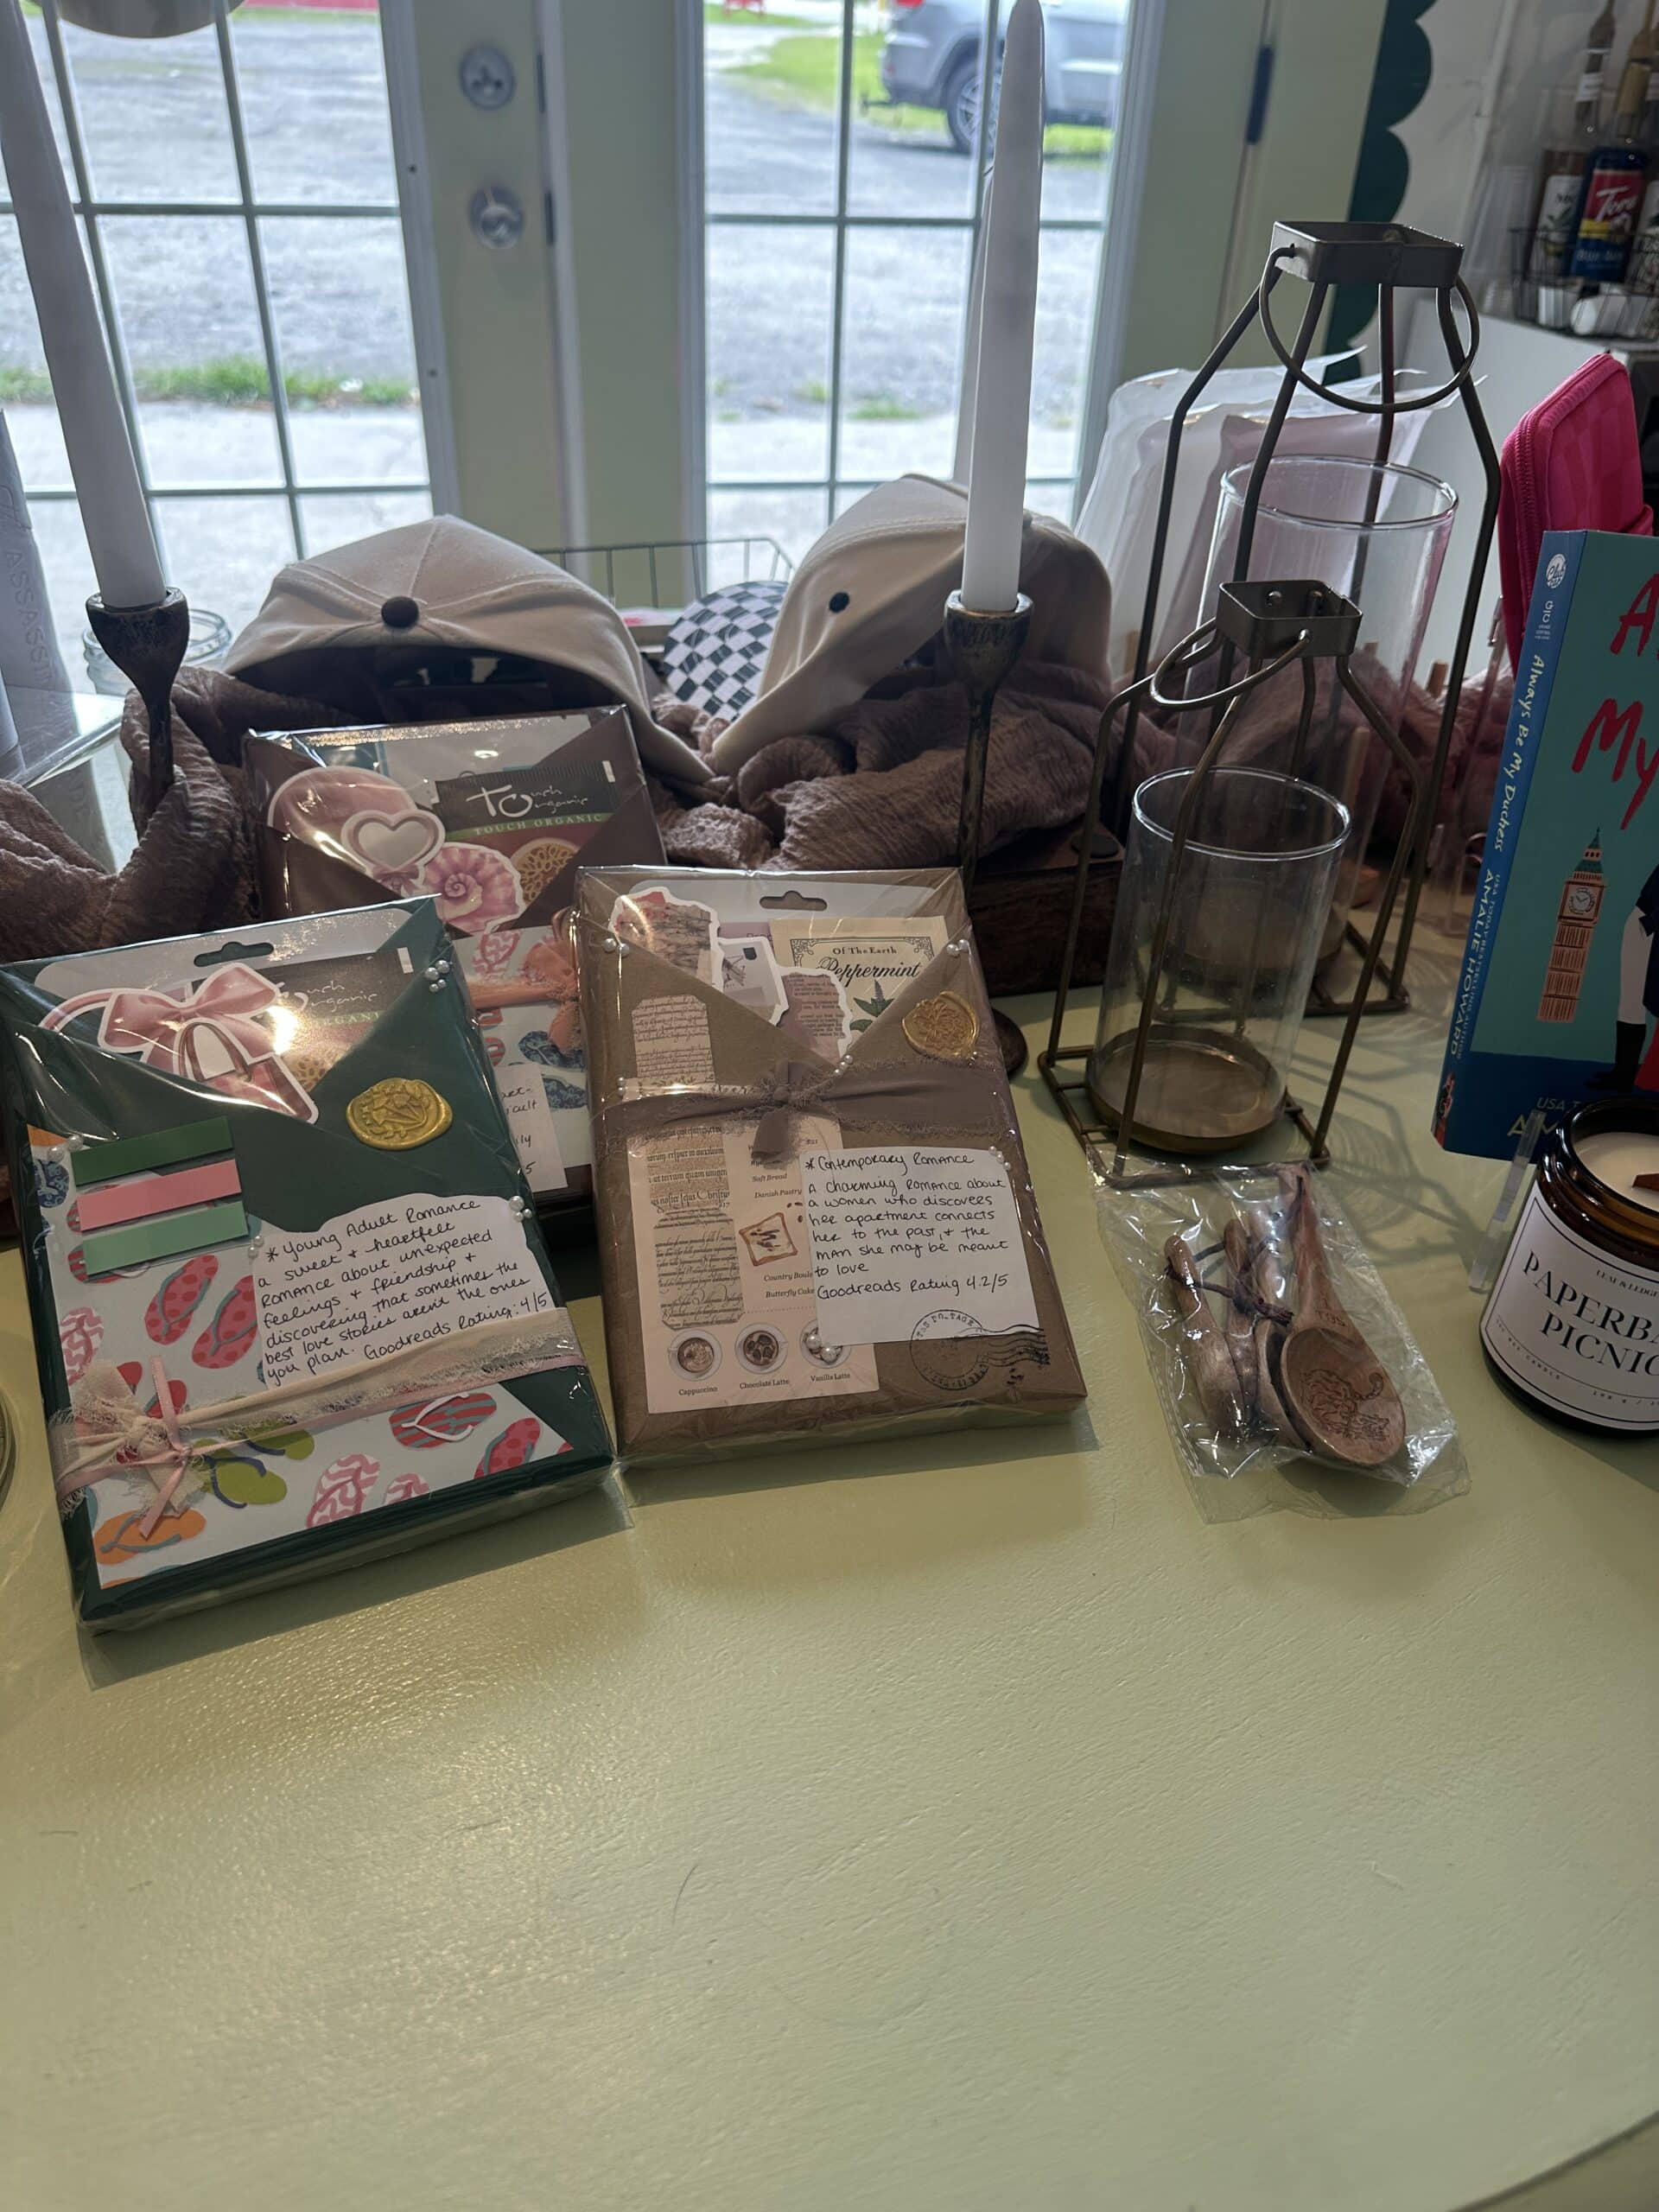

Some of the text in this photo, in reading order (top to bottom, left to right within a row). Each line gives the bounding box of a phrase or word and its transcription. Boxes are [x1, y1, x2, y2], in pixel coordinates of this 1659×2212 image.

[1518, 654, 1545, 718] Always
[1516, 724, 1529, 747] Be
[1503, 752, 1522, 779] My
[474, 813, 603, 836] TOUCH ORGANIC
[1495, 784, 1516, 852] Duchess
[832, 946, 846, 955] Of
[848, 946, 868, 955] The
[1452, 868, 1494, 1055] AMALIE HOWARD
[816, 956, 922, 988] Peppermint
[913, 1152, 975, 1166] Romance
[967, 1179, 1007, 1189] about
[809, 1194, 993, 1208] a women who discovers
[346, 1212, 398, 1236] Adult
[406, 1199, 480, 1224] Romance
[809, 1211, 995, 1227] her apartment connects
[812, 1230, 841, 1243] her
[852, 1229, 867, 1239] to
[874, 1227, 899, 1238] the
[961, 1225, 990, 1238] the
[258, 1276, 270, 1288] a
[285, 1255, 342, 1281] sweet
[365, 1223, 455, 1253] heartfelt
[341, 1258, 391, 1283] about
[399, 1230, 493, 1264] unexpected
[817, 1240, 1009, 1261] man she may be meant
[815, 1262, 869, 1277] to love
[264, 1295, 341, 1328] feelings
[372, 1258, 456, 1296] friendship
[817, 1281, 901, 1300] Goodreads
[910, 1275, 960, 1296] Rating
[266, 1261, 518, 1349] discovering that sometimes the
[264, 1346, 295, 1365] best
[303, 1338, 333, 1355] love
[340, 1313, 397, 1341] stories
[457, 1285, 483, 1302] the
[490, 1278, 531, 1294] ones
[266, 1363, 301, 1388] you
[364, 1322, 452, 1361] Goodreads
[520, 1291, 548, 1314] 4/5
[678, 1385, 718, 1396] Cappuccino
